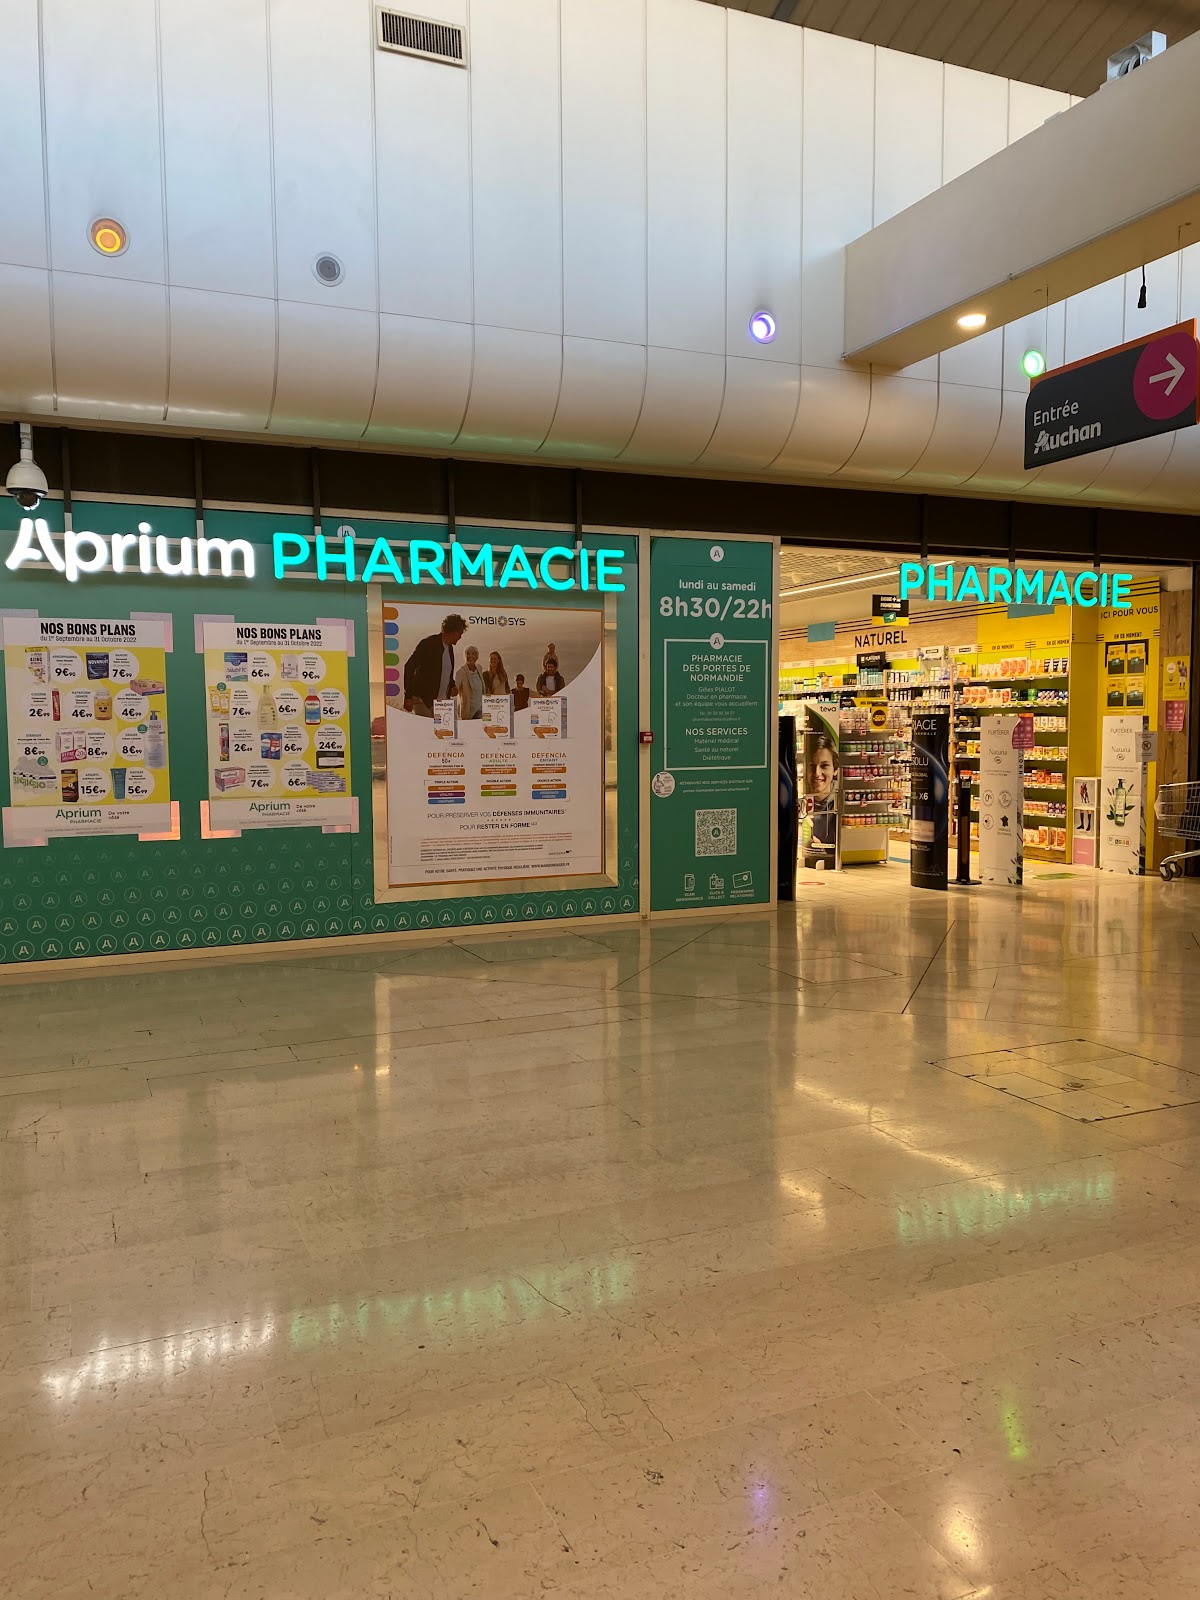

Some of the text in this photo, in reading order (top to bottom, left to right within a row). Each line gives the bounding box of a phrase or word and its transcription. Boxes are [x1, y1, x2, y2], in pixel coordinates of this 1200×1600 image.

[1033, 400, 1079, 426] Entrée
[1034, 421, 1101, 454] Auchan
[5, 517, 626, 592] Aprium PHARMACIE
[679, 579, 756, 591] lundi au samedi
[899, 562, 1133, 608] PHARMACIE
[660, 596, 771, 621] 8h30/22h
[1112, 609, 1134, 618] POUR
[1137, 606, 1159, 614] VOUS
[468, 616, 526, 627] SYMBIOSYS
[41, 623, 136, 636] NOS BONS PLANS
[237, 628, 322, 640] NOS BONS PLANS
[854, 630, 908, 648] NATUREL
[692, 655, 743, 663] PHARMACIE
[683, 664, 700, 672] DES
[703, 664, 737, 672] PORTES
[690, 674, 744, 682] NORMANDIE
[686, 728, 748, 736] NOS SERVICES
[249, 802, 291, 813] Aprium
[55, 808, 102, 820] Aprium
